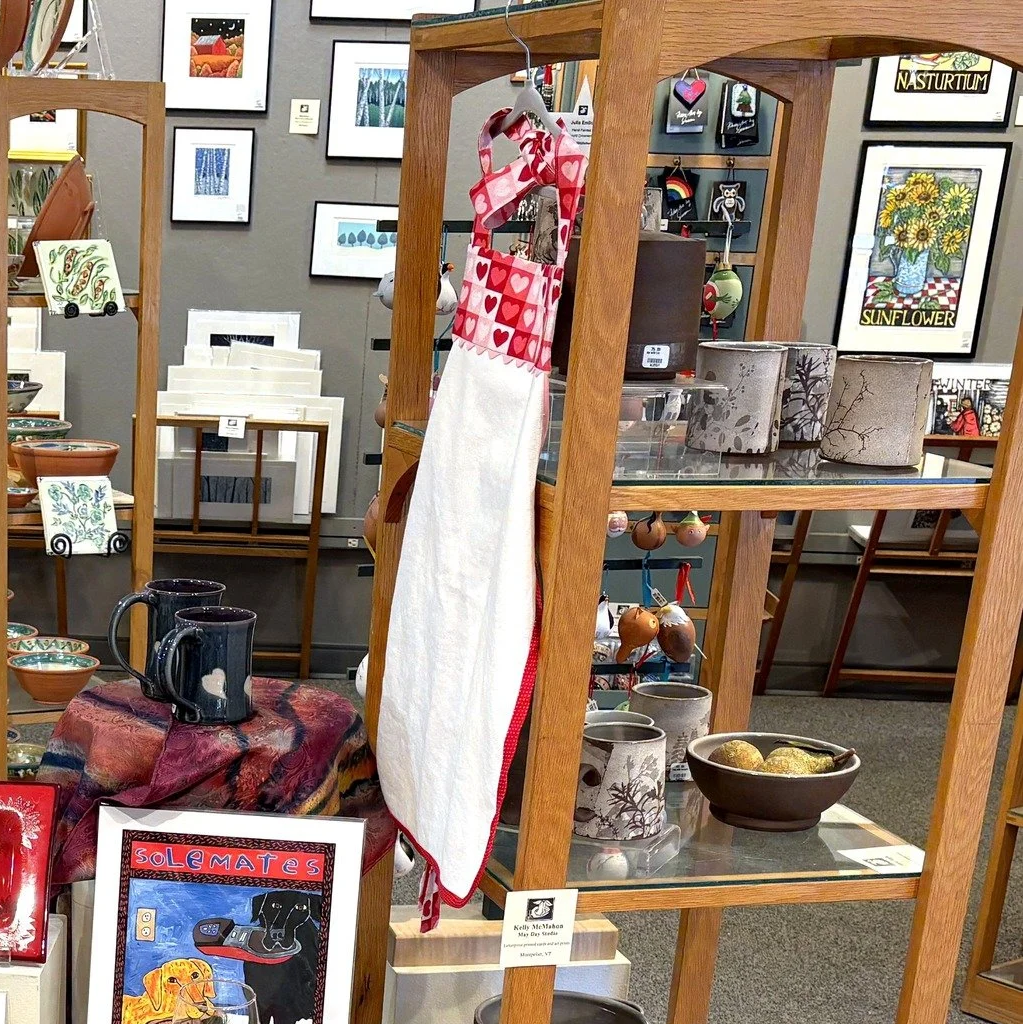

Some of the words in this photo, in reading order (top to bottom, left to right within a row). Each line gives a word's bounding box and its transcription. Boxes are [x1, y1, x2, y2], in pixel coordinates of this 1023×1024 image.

[896, 71, 988, 90] NASTURTIUM
[860, 309, 955, 326] SUNFLOWER
[938, 377, 992, 391] WINTER
[532, 923, 564, 931] McMahon
